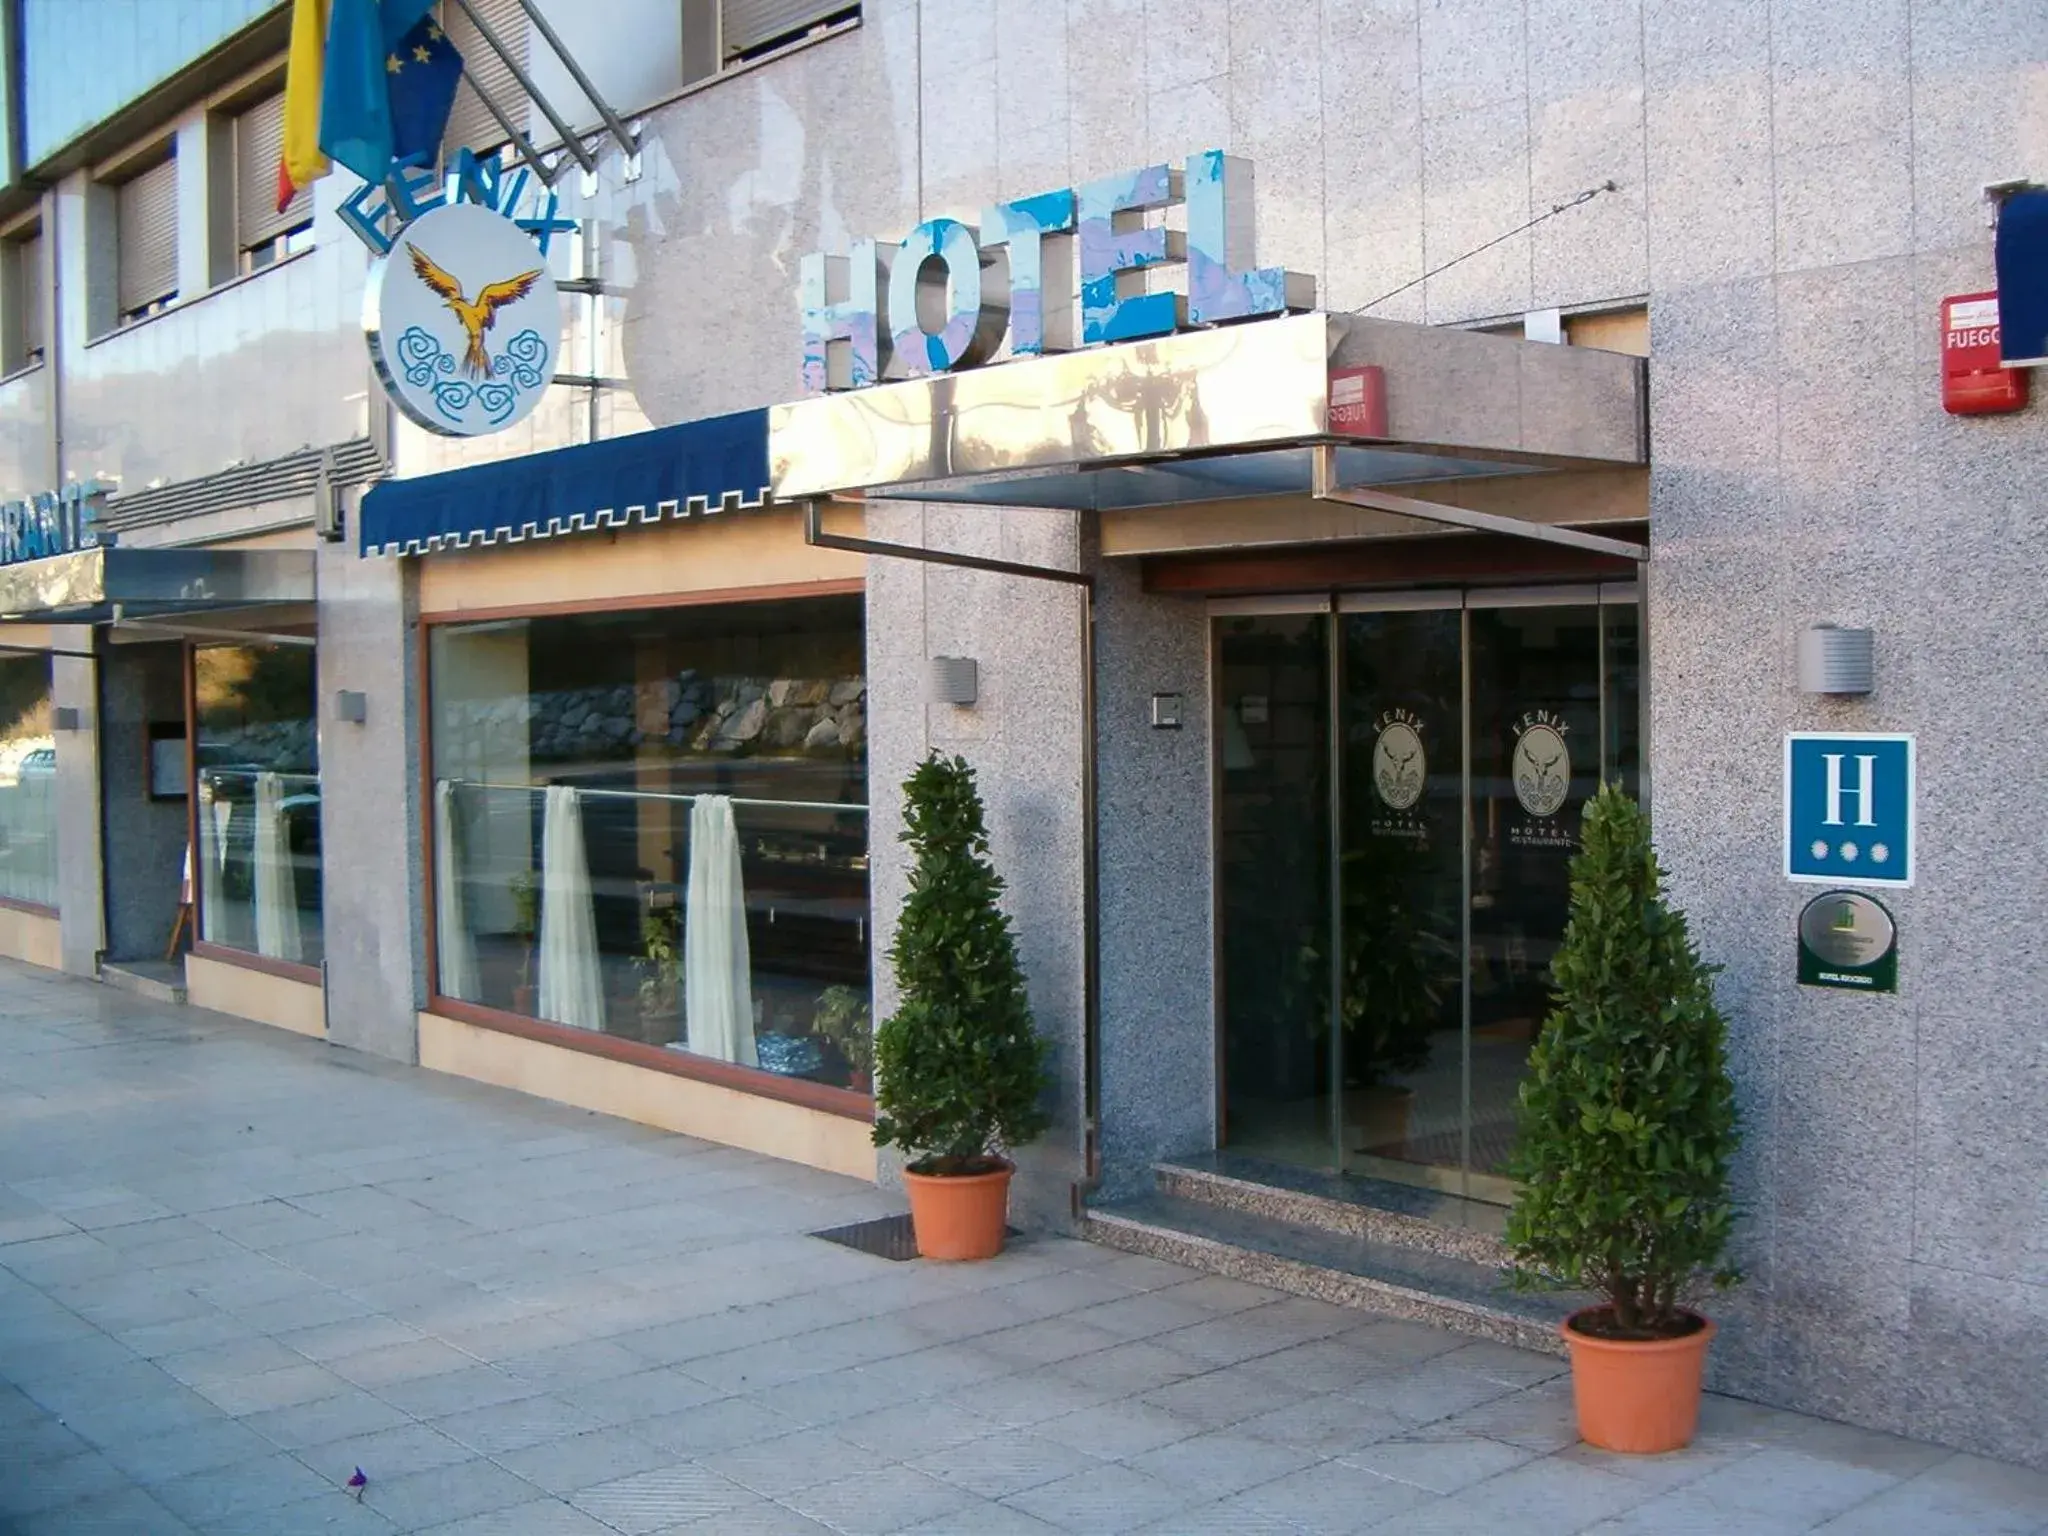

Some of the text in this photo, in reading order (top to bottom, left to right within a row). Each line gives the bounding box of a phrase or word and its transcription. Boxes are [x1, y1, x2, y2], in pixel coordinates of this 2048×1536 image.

[338, 145, 578, 258] FENIX
[800, 150, 1304, 392] HOTEL
[0, 481, 112, 564] RANTE
[1511, 708, 1571, 737] FENIX
[1821, 753, 1879, 827] H
[1510, 826, 1571, 838] HOTEL
